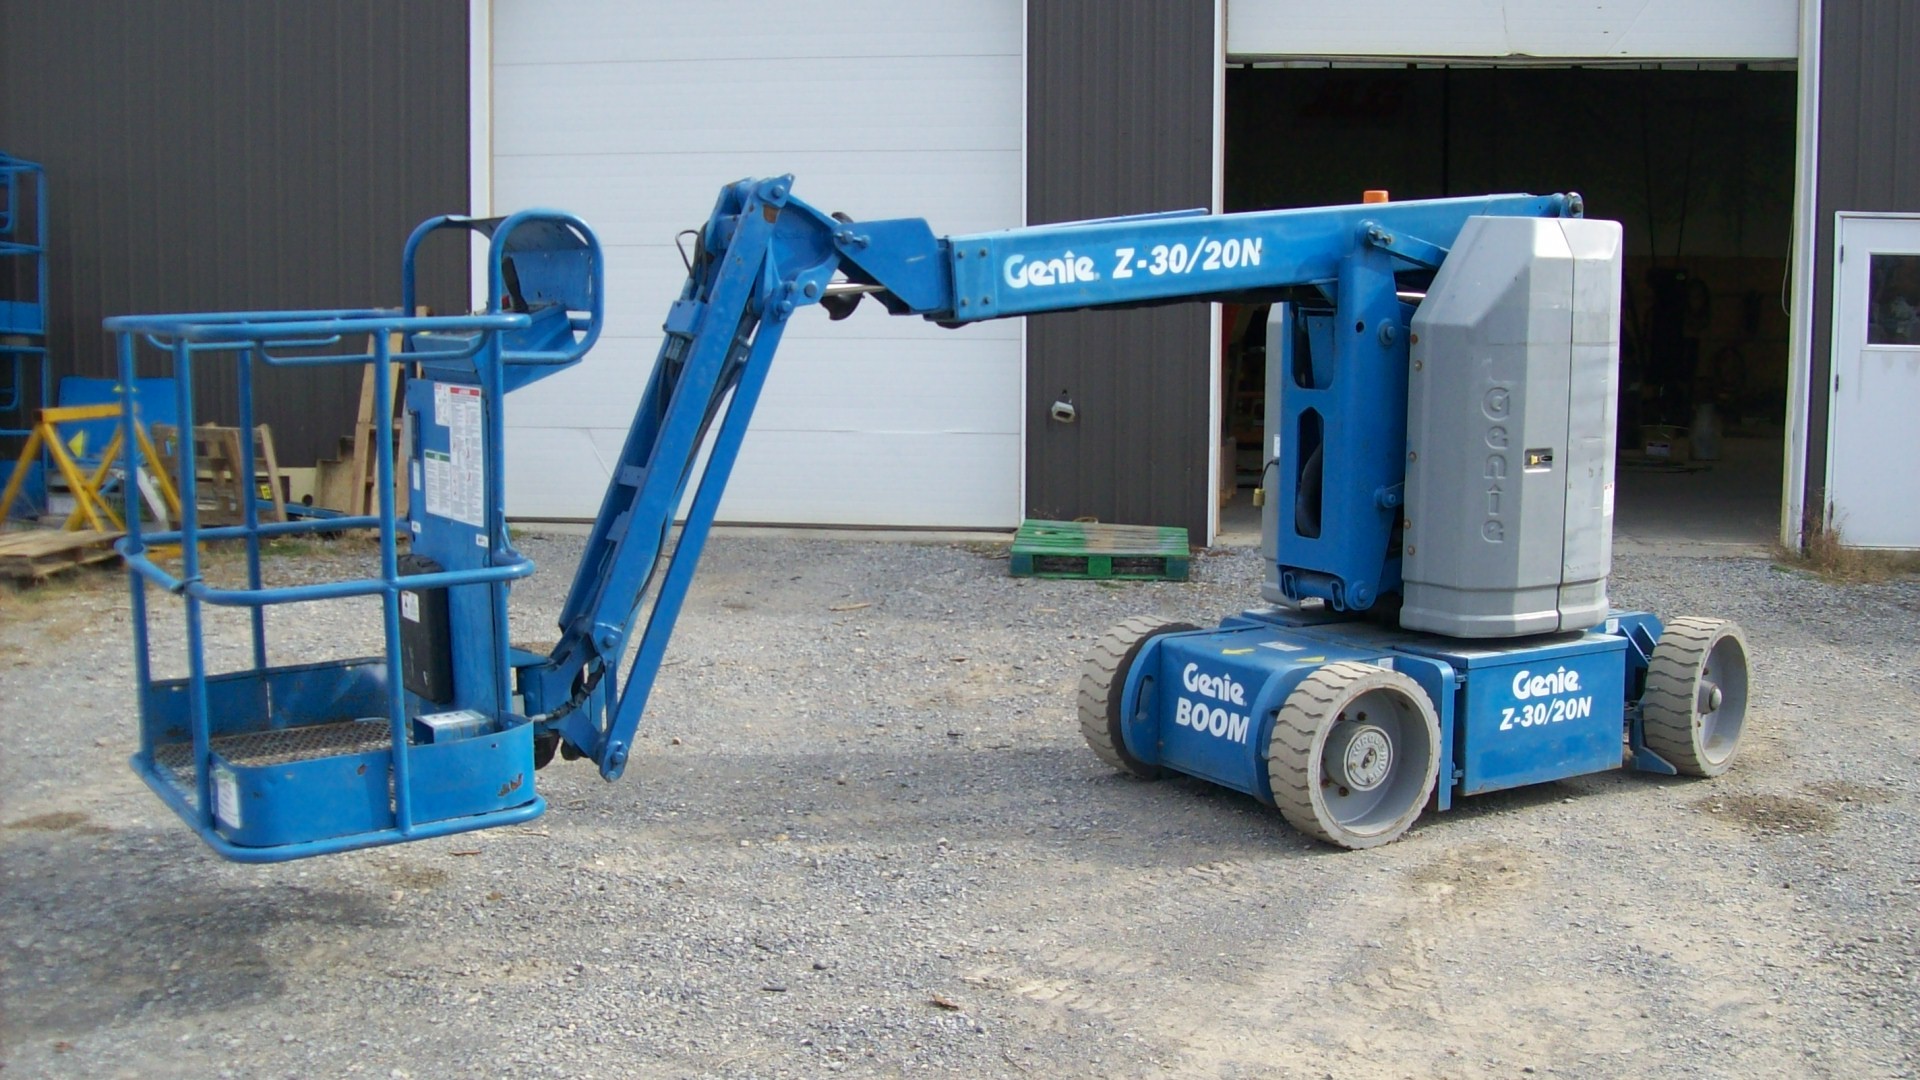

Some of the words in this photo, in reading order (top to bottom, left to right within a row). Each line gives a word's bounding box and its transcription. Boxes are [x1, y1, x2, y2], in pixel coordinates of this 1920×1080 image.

[1003, 250, 1098, 289] Genie
[1112, 236, 1263, 280] Z-30/20N
[1481, 386, 1510, 544] Genie
[1183, 662, 1246, 706] Genie
[1512, 665, 1580, 700] Genie
[1175, 696, 1250, 745] BOOM
[1499, 696, 1593, 731] Z-30/20N
